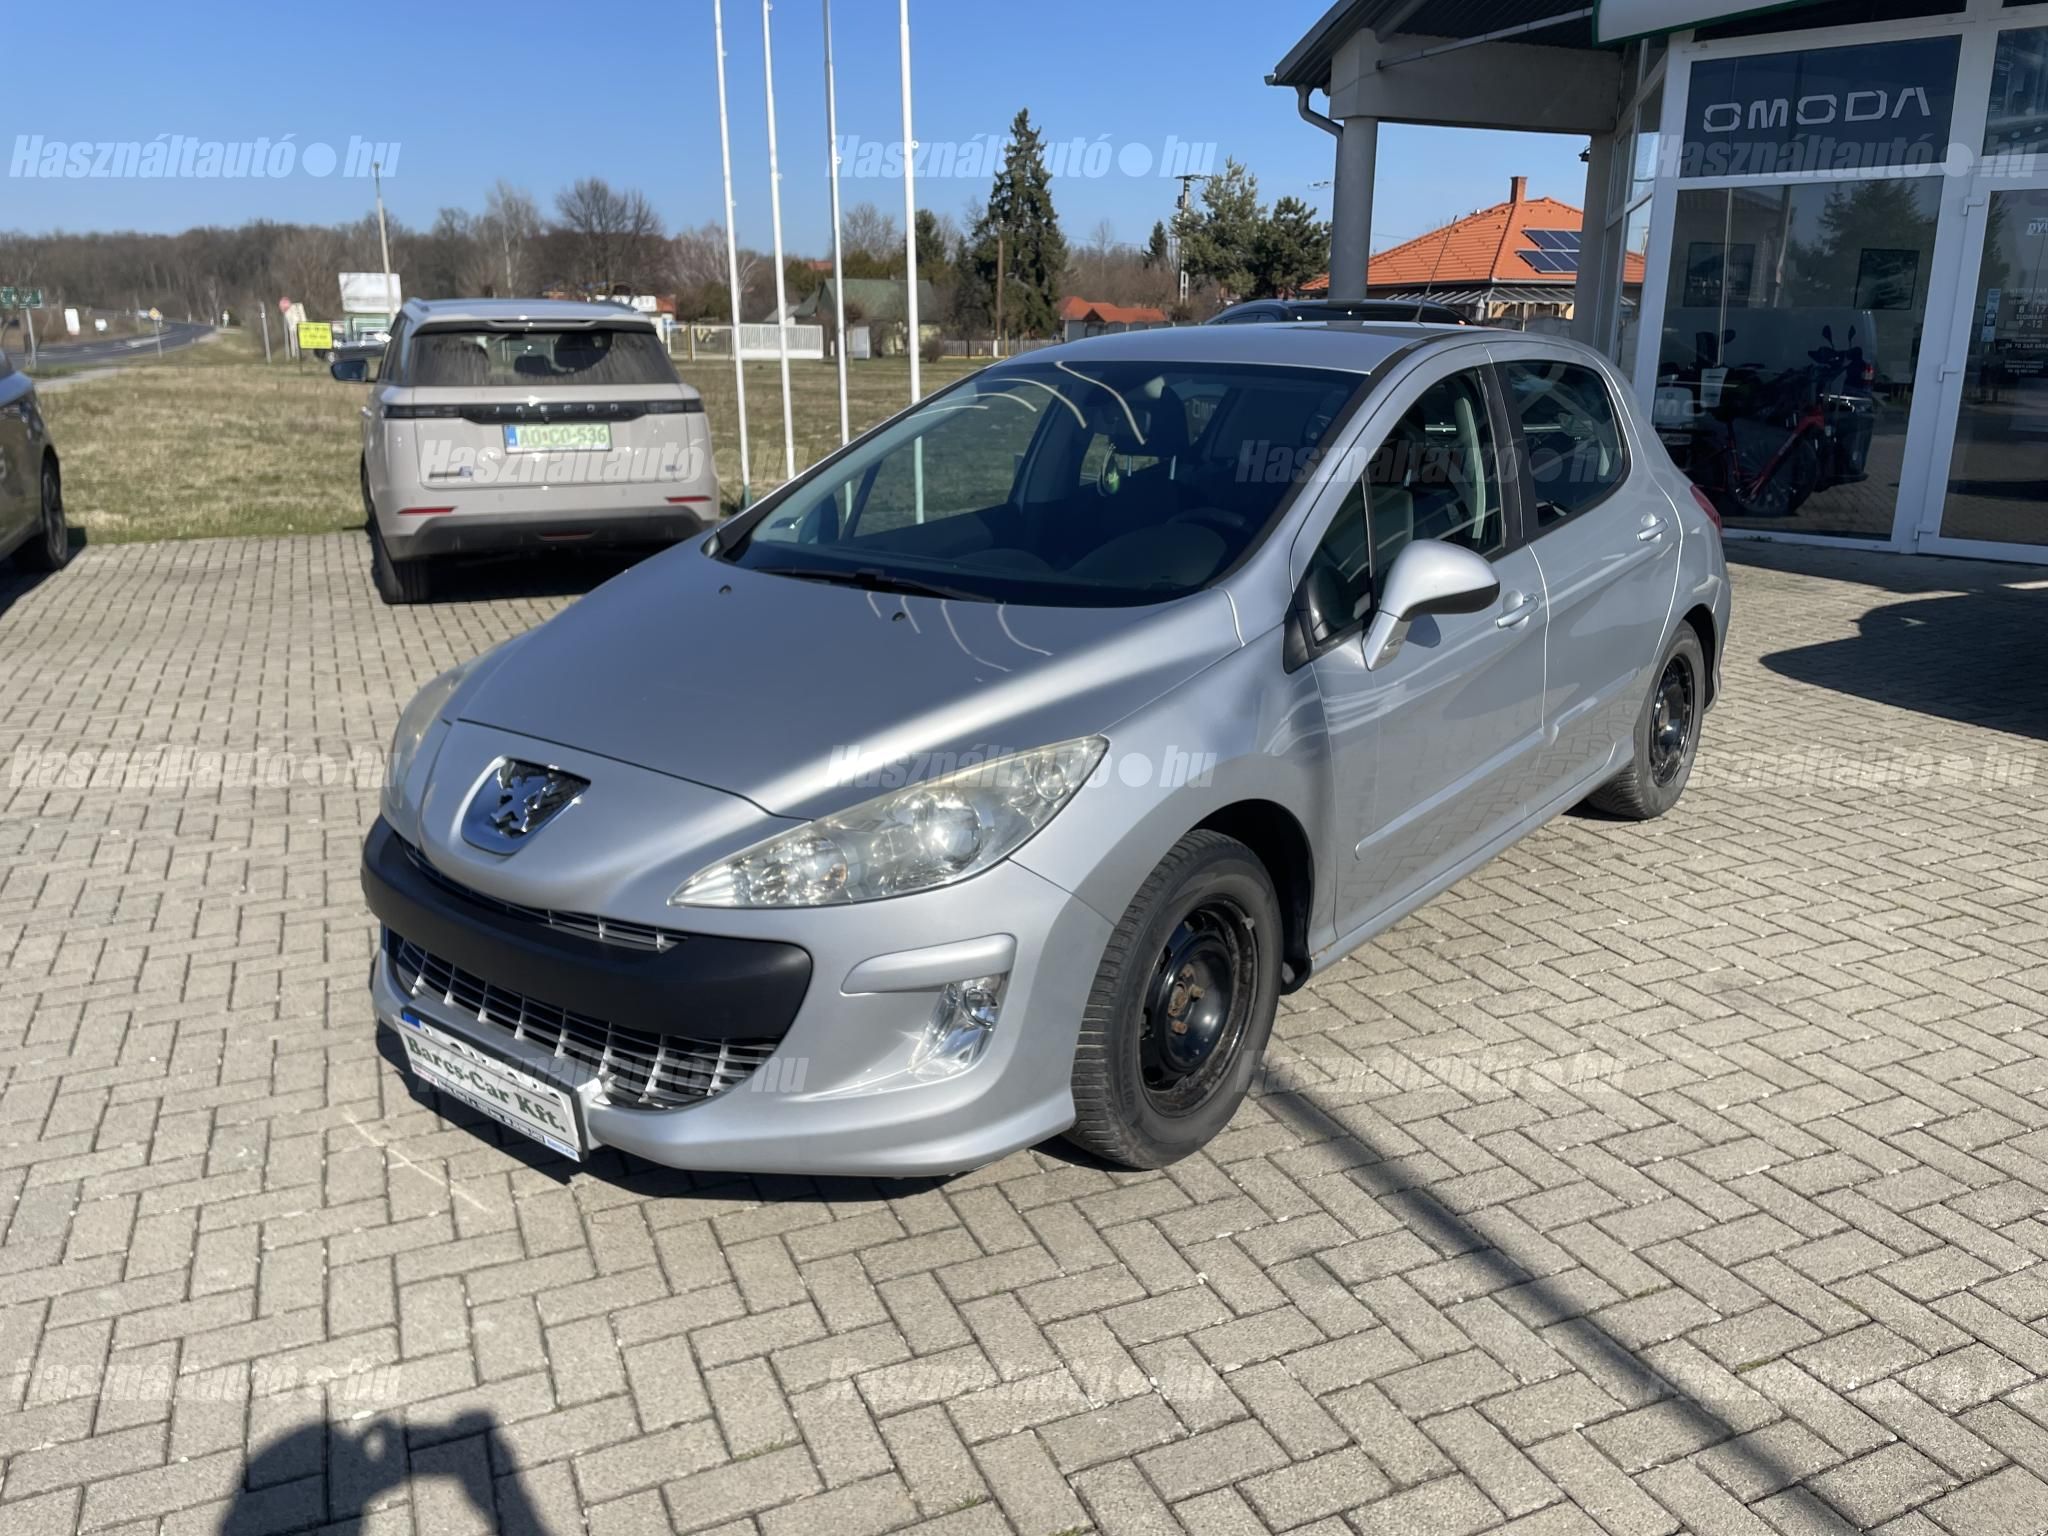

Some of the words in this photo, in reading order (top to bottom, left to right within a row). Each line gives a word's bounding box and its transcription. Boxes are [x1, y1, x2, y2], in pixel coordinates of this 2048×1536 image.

[1702, 86, 1931, 134] OMODA
[403, 1035, 509, 1101] Barcs-Car
[513, 1090, 568, 1133] Kft.
